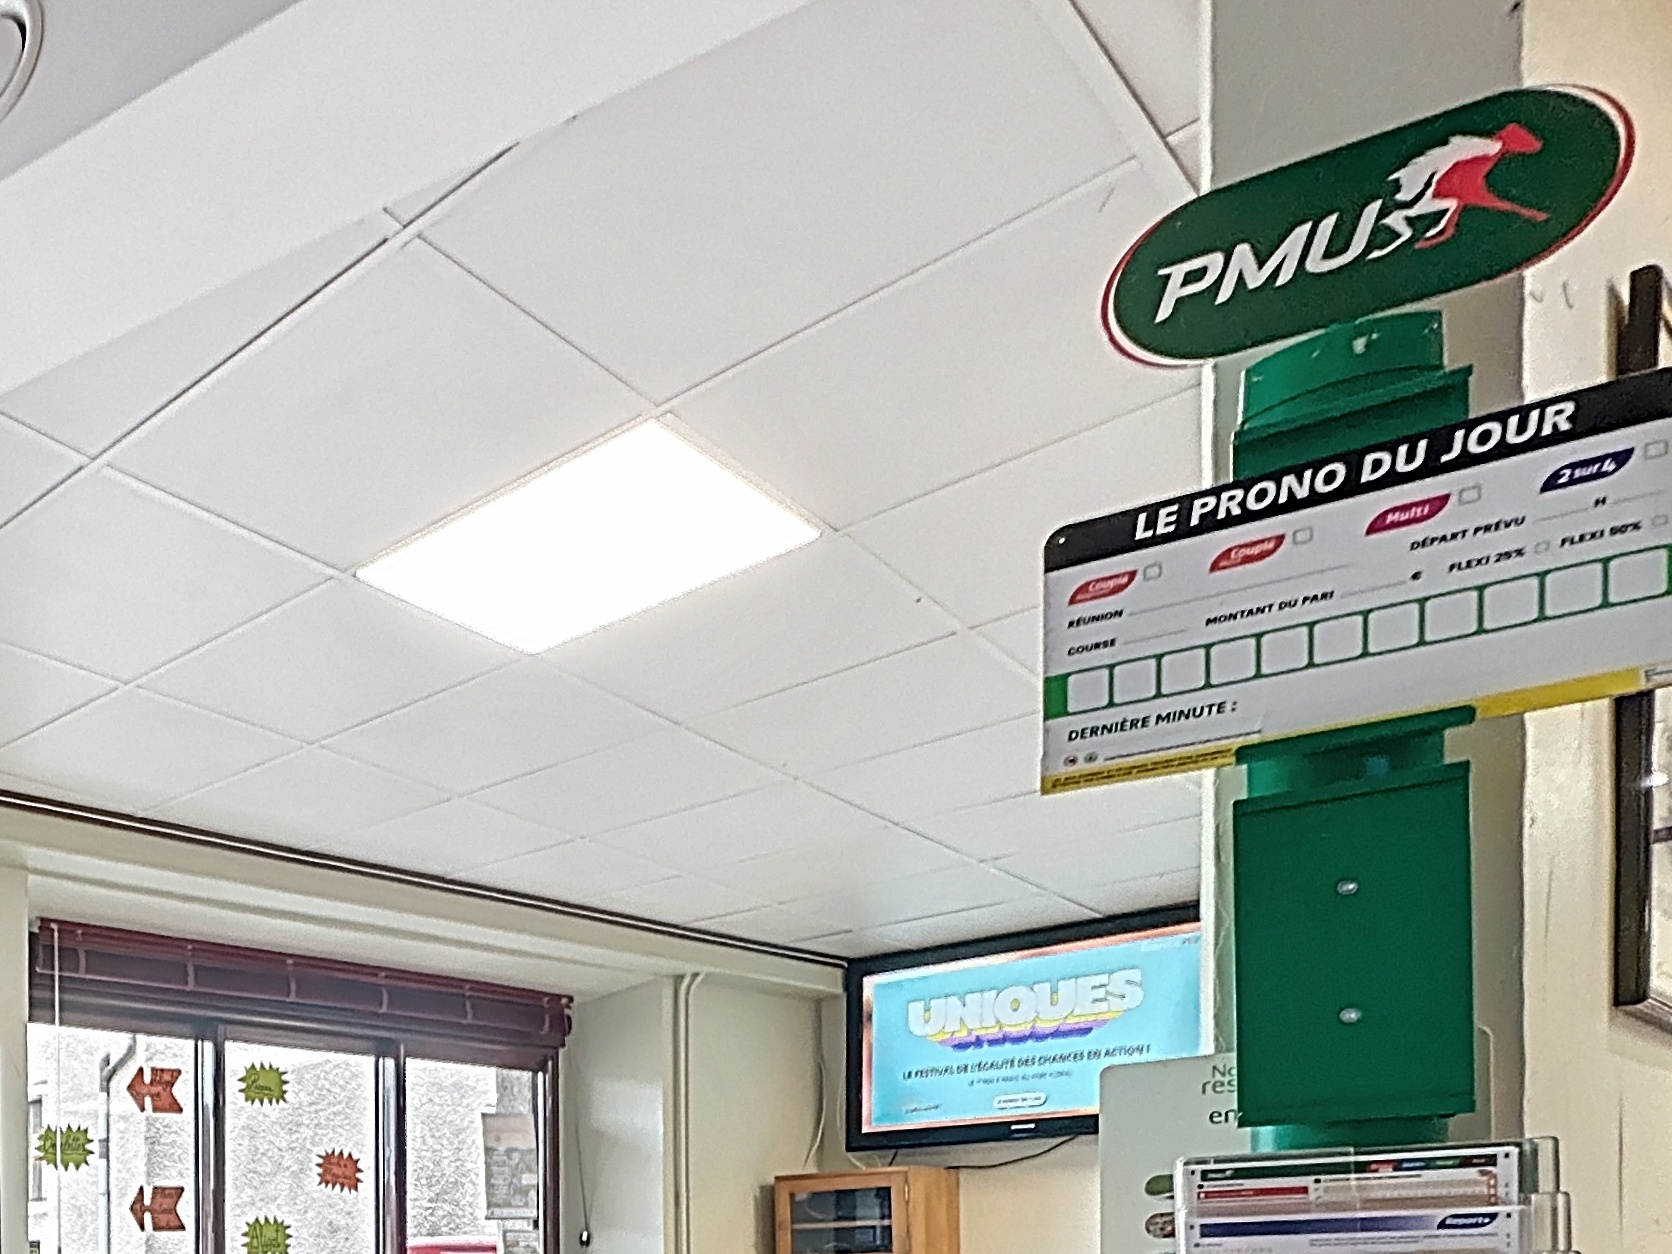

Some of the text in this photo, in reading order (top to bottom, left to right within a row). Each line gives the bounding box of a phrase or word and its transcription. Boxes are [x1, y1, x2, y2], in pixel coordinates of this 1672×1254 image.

[1153, 199, 1383, 324] PMU
[1134, 401, 1577, 542] LE PRONO DU JOUR
[1409, 528, 1468, 552] DÉPART
[1473, 515, 1527, 538] PRÉVU
[1559, 529, 1606, 549] FLEXI
[1447, 554, 1490, 575] FLEXI
[1066, 608, 1125, 630] RÉUNION
[1204, 603, 1276, 628] MONTANT
[1277, 597, 1299, 612] DU
[1301, 590, 1336, 608] PARI
[1066, 638, 1118, 657] COURSE
[1067, 714, 1152, 743] DERNIÈRE
[1155, 700, 1227, 726] MINUTE
[906, 966, 1146, 1038] UNIQUES
